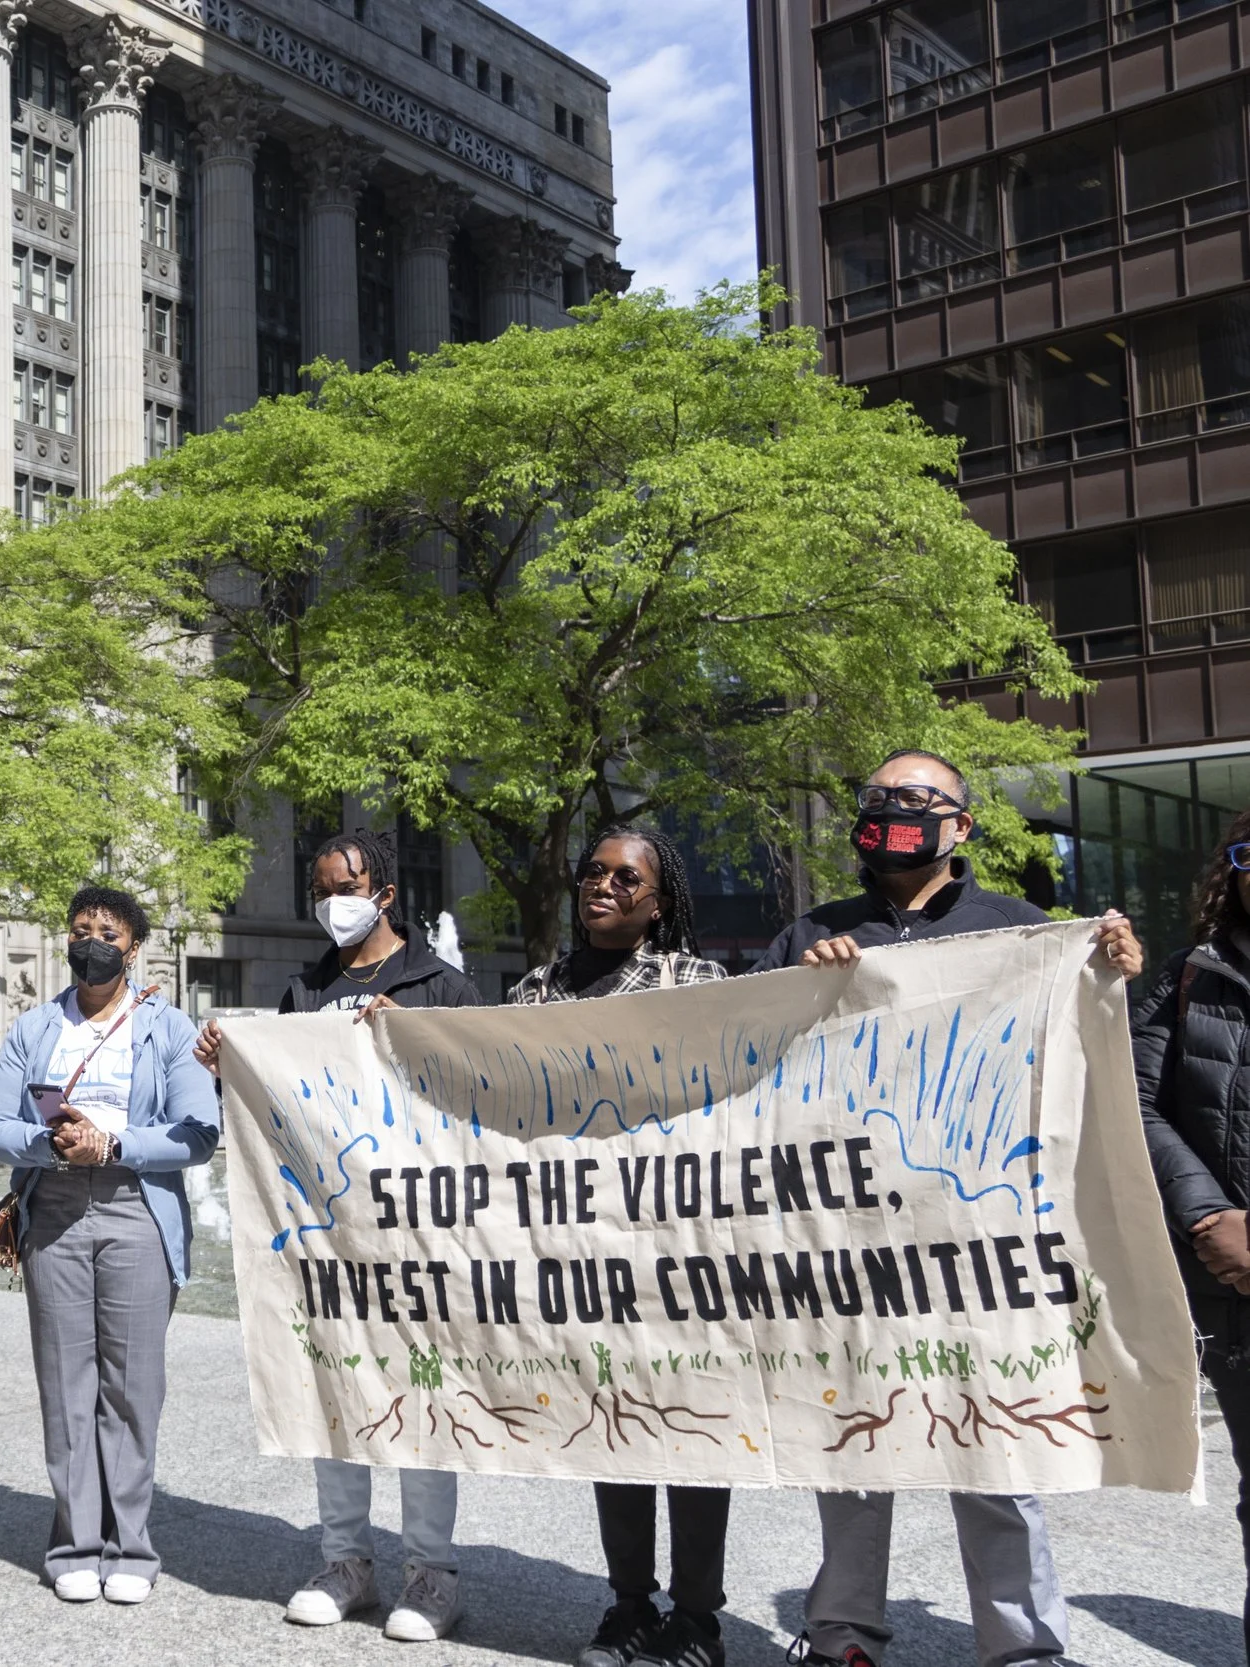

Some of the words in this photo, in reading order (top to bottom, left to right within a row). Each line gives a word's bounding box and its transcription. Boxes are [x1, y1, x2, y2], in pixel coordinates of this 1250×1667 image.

[889, 824, 922, 836] CHICAGO
[887, 833, 924, 846] FREEDOM
[340, 995, 357, 1010] BY
[369, 1164, 490, 1229] STOP
[506, 1159, 599, 1227] THE
[618, 1136, 903, 1222] VIOLENCE,
[298, 1259, 451, 1323] INVEST
[470, 1259, 520, 1325] IN
[537, 1258, 642, 1324] OUR
[656, 1231, 1078, 1322] COMMUNITIES
